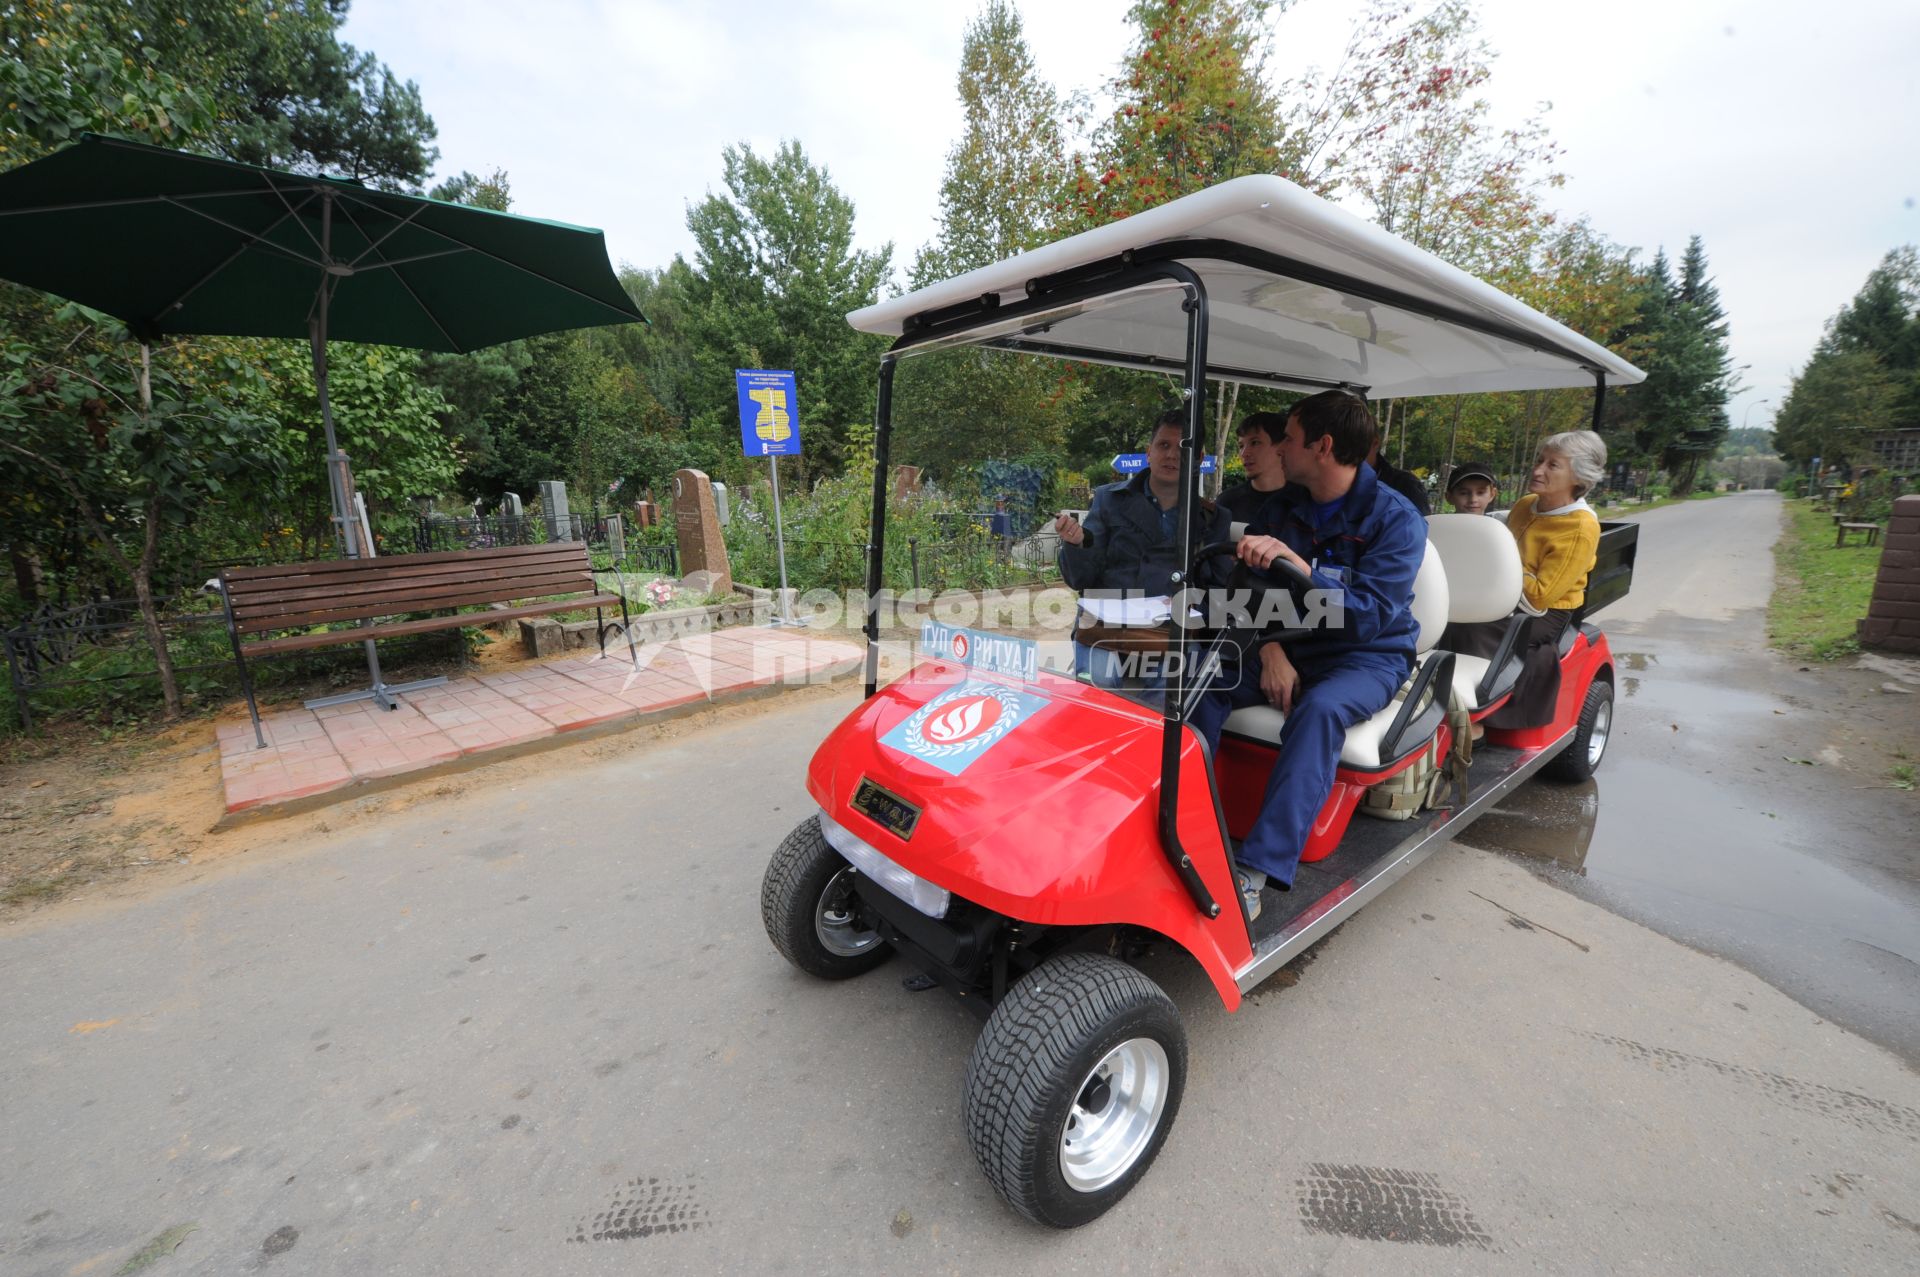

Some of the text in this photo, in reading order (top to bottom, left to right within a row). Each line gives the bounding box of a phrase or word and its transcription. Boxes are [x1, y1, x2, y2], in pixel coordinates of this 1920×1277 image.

[1120, 459, 1142, 468] ТУАЛЕТ
[923, 624, 1036, 674] ГУП РИТУАЛ
